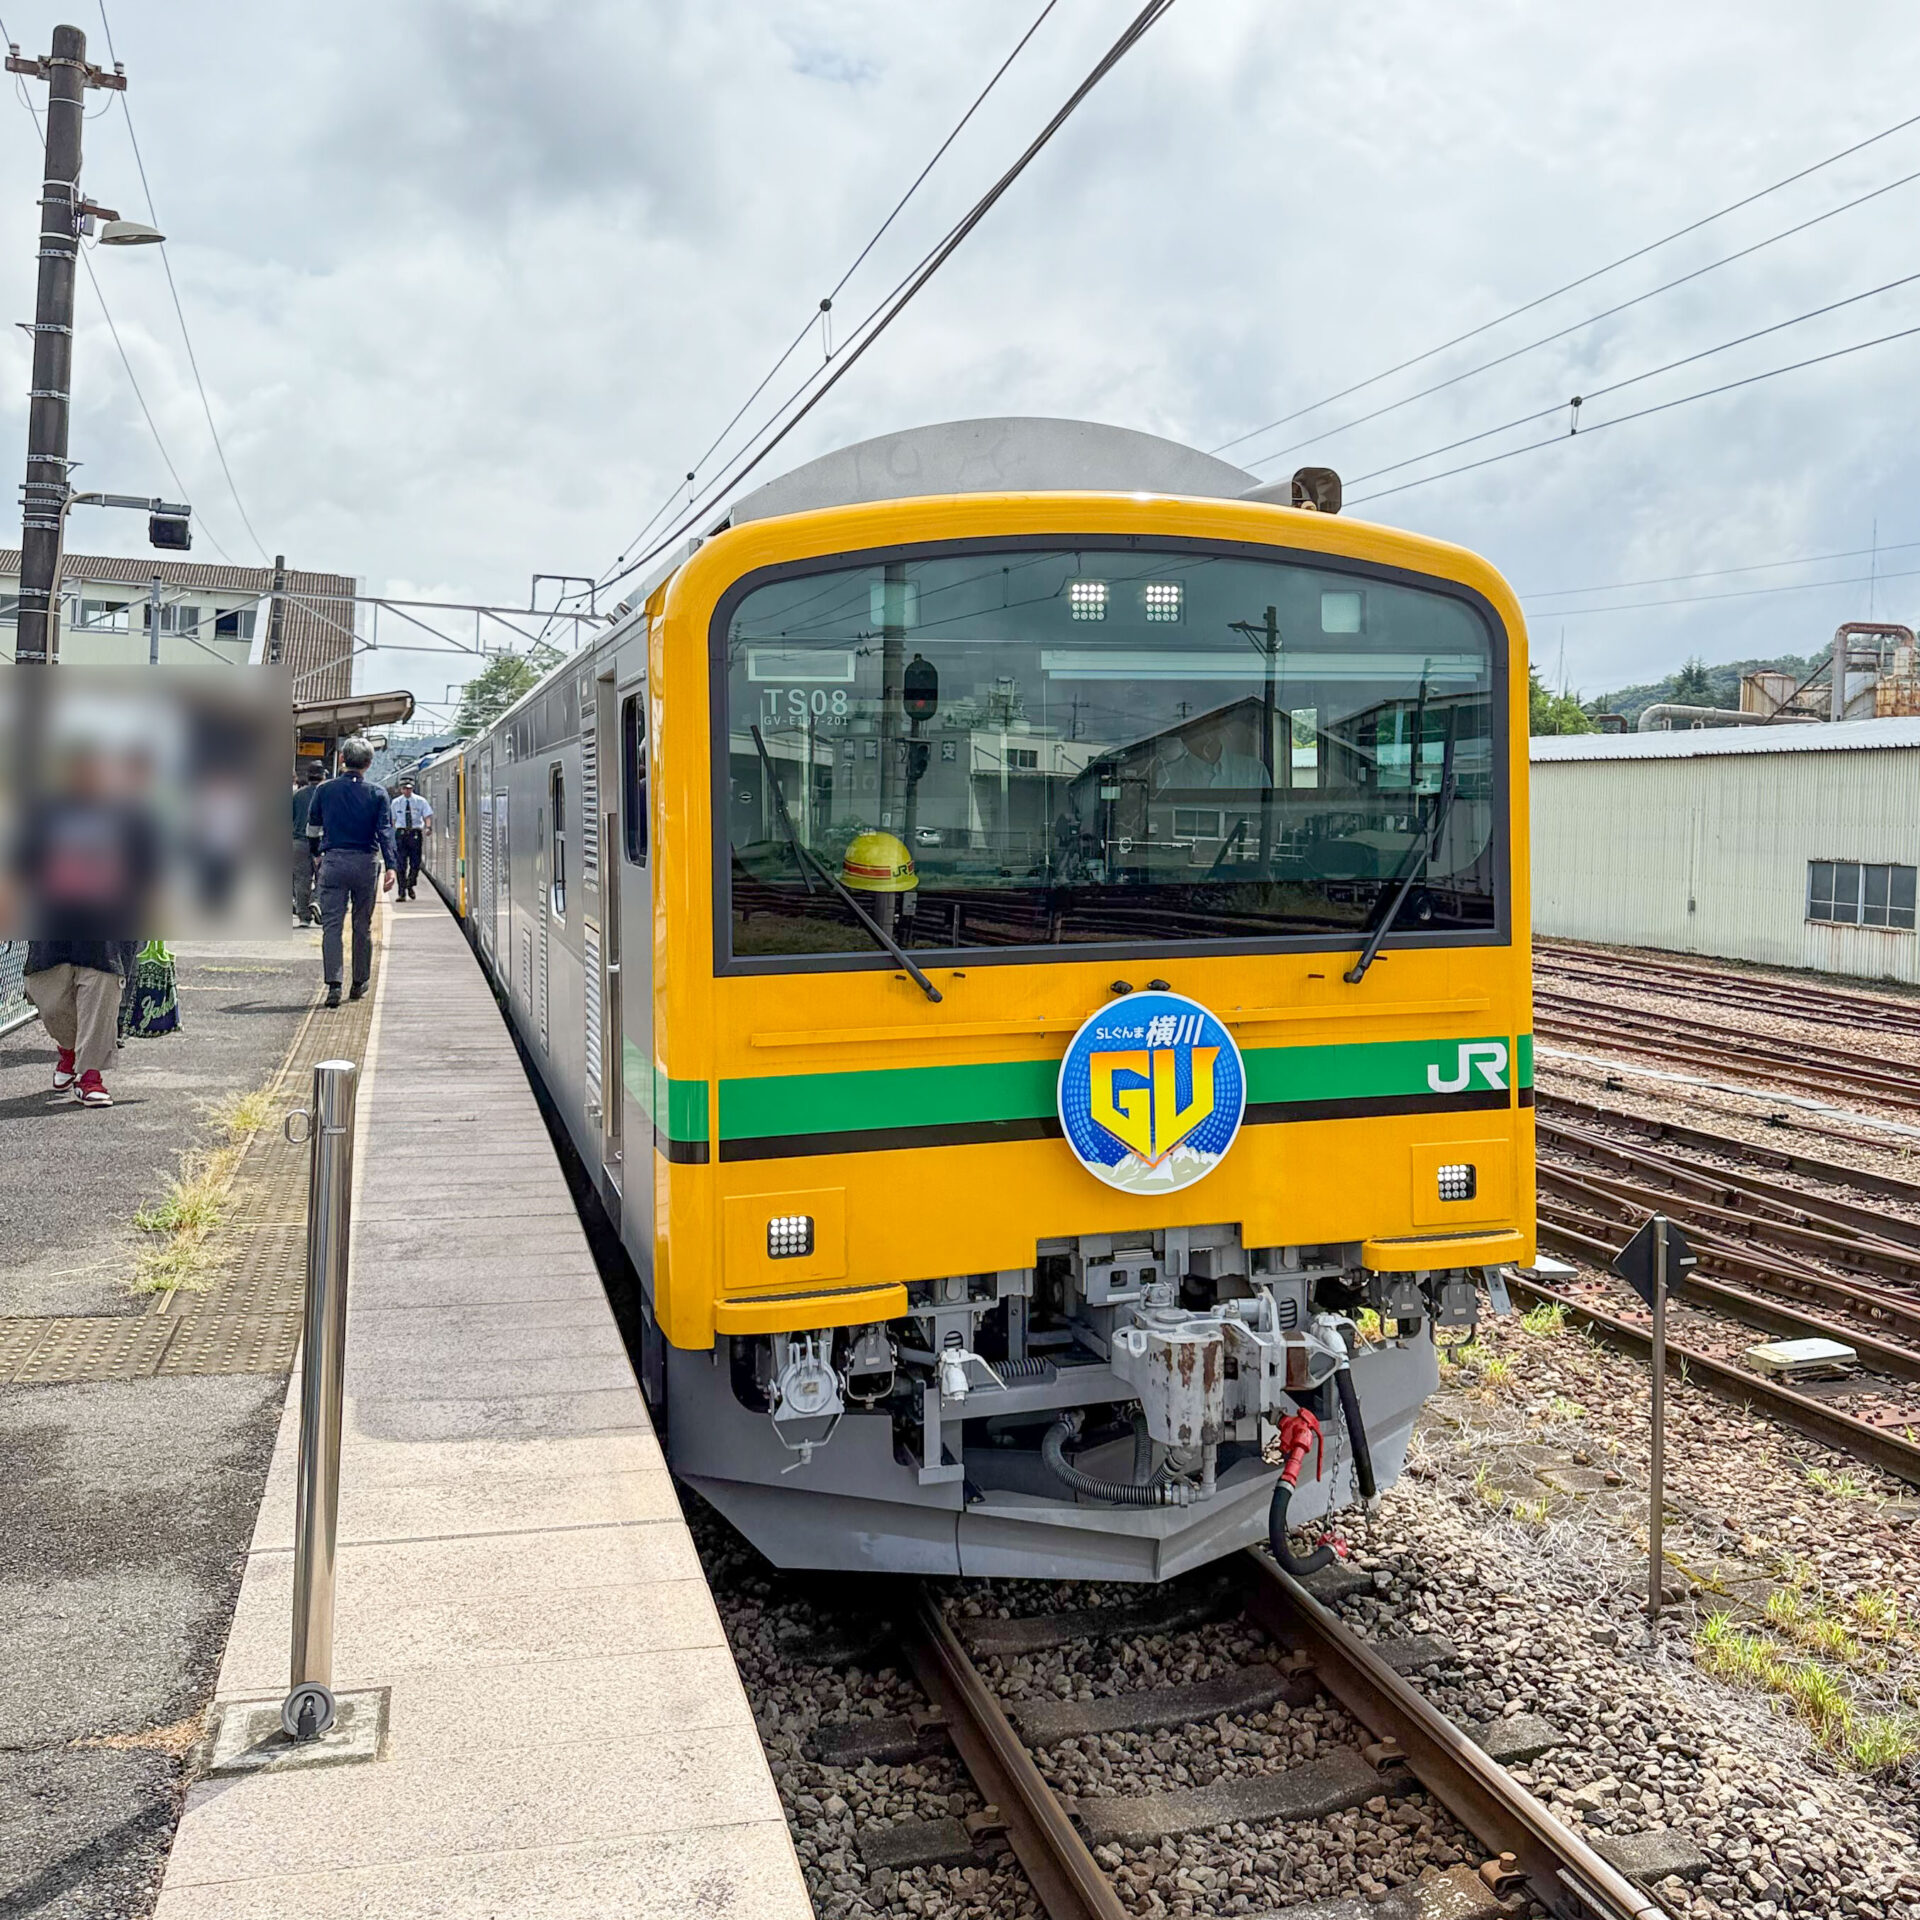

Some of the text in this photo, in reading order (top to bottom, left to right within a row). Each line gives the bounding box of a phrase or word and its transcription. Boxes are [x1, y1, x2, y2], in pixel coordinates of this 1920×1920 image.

[763, 688, 848, 715] TS08
[892, 864, 907, 877] JR
[1095, 1014, 1205, 1047] SLぐんま 横川
[1427, 1042, 1508, 1093] JR
